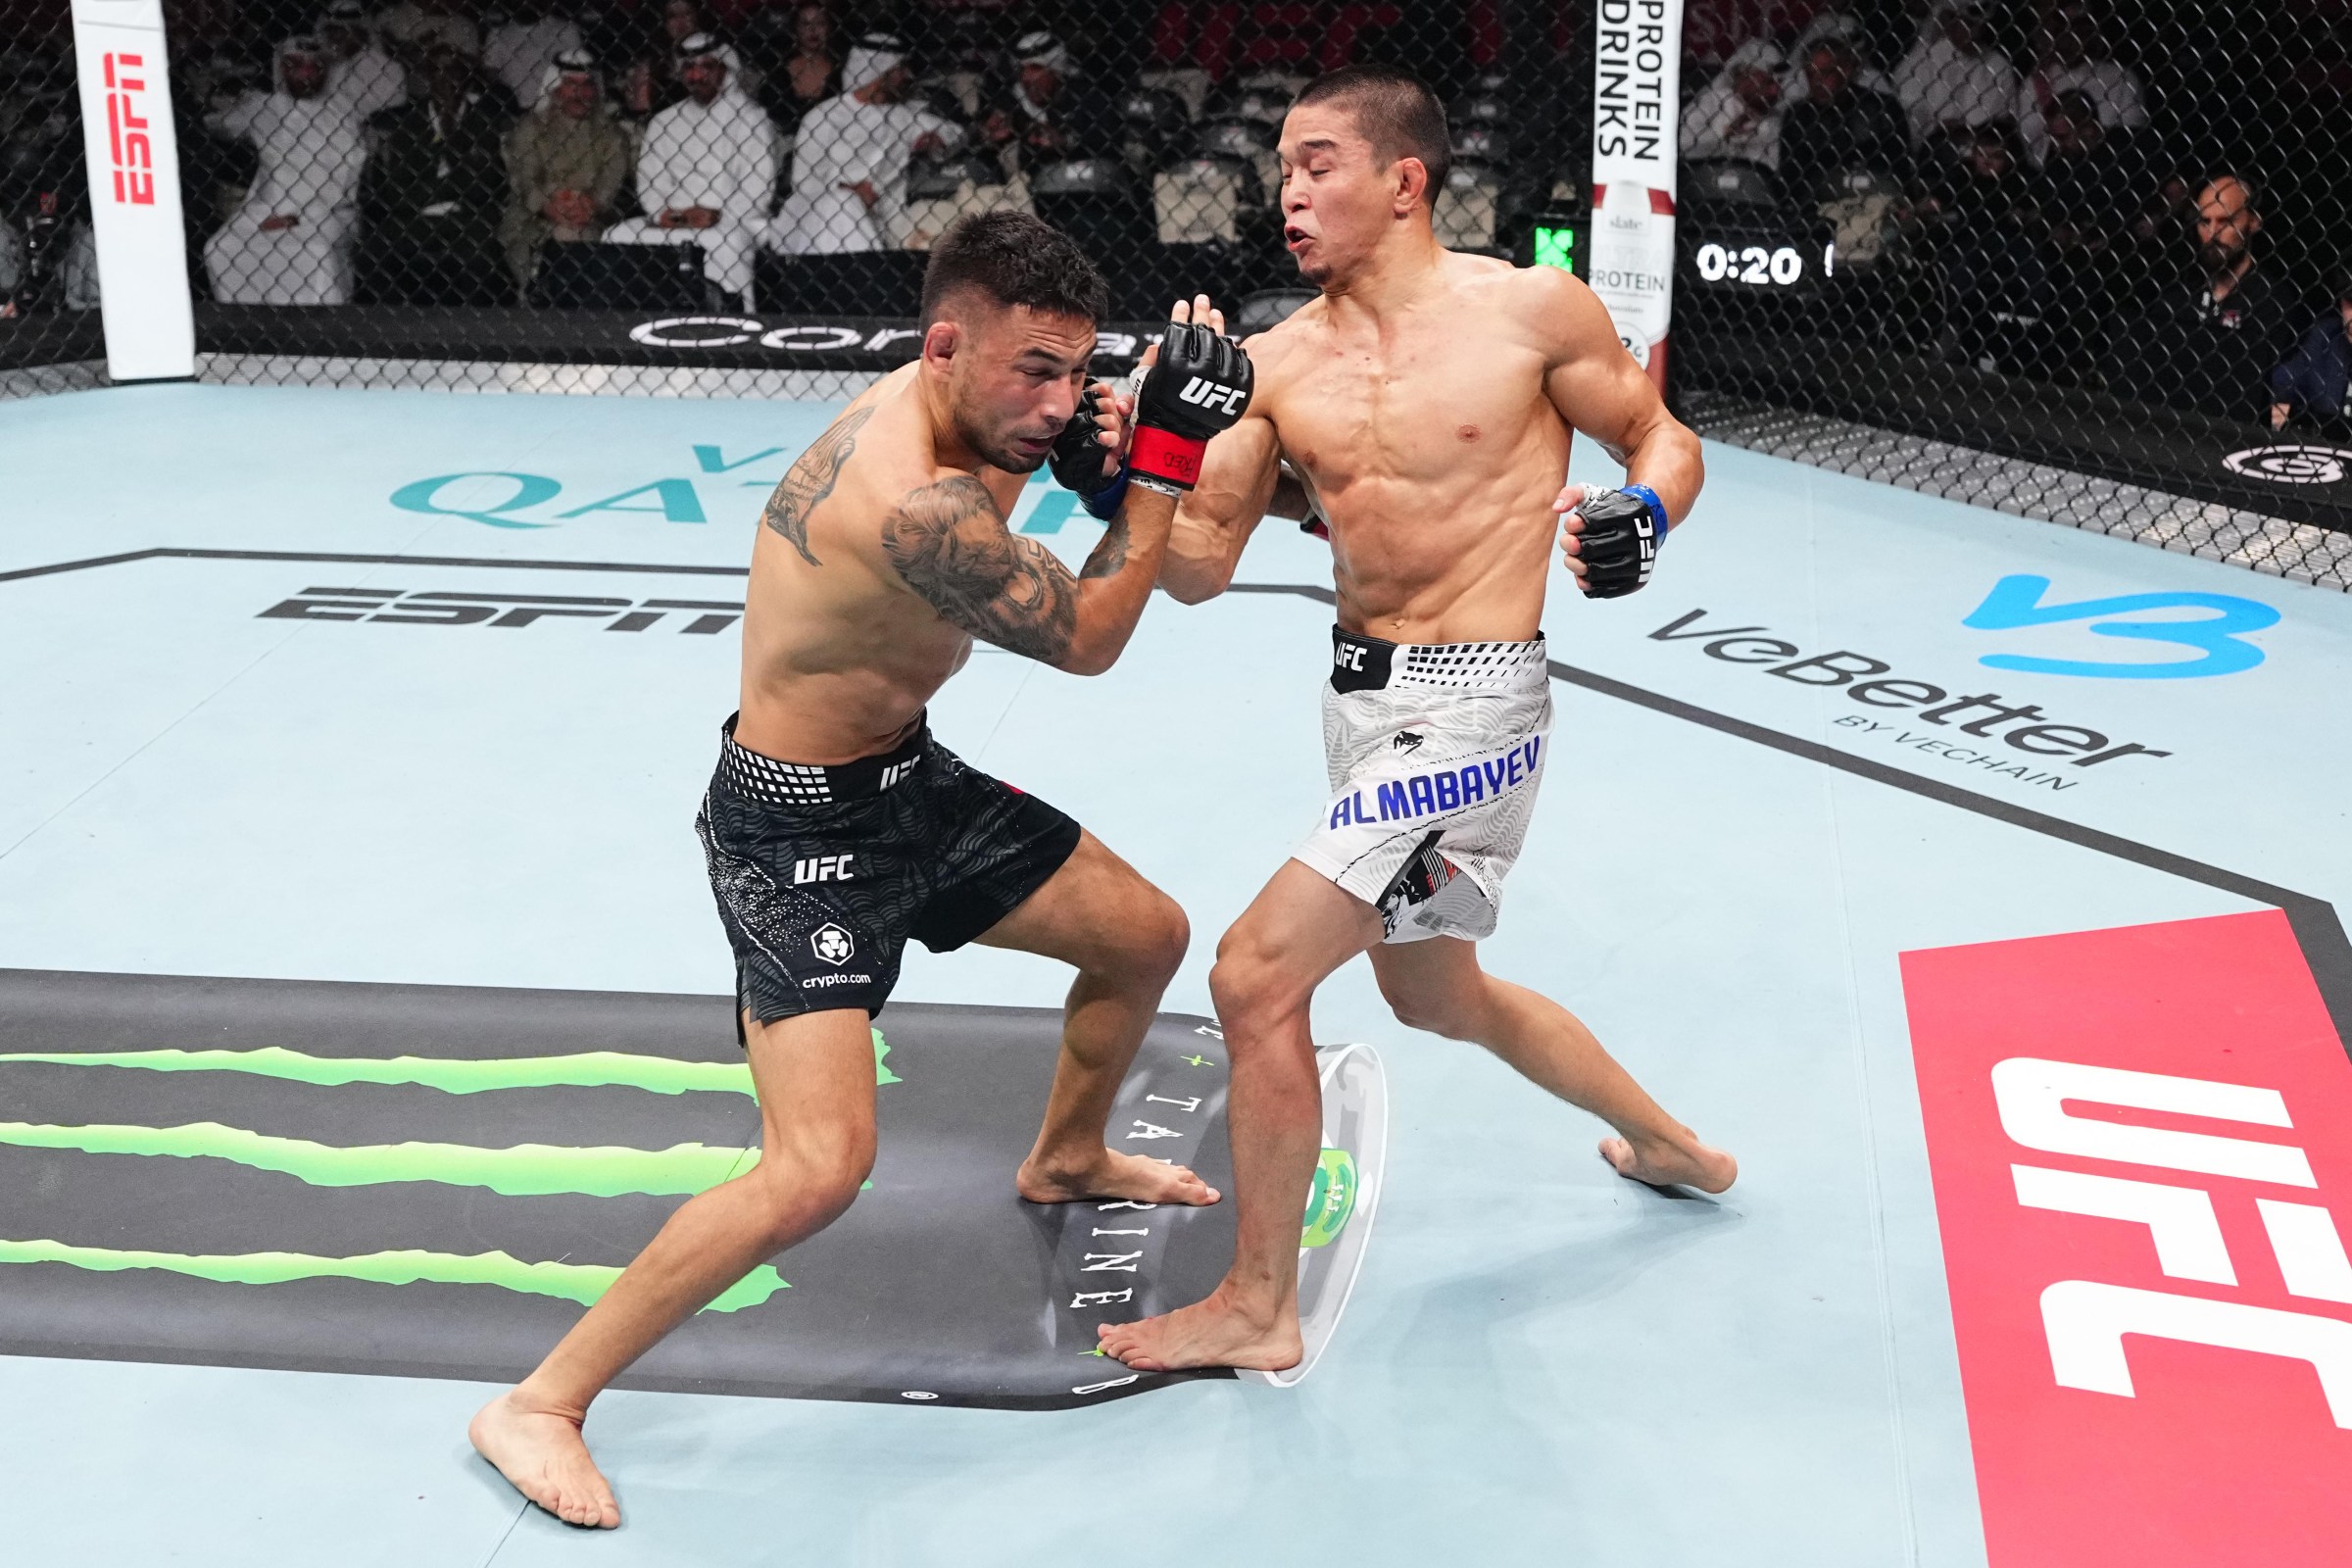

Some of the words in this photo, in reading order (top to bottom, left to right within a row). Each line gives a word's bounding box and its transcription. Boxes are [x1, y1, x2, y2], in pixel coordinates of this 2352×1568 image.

[1598, 0, 1630, 157] DRINKS
[1633, 0, 1664, 161] PROTEIN
[103, 52, 155, 205] ESPN
[1696, 244, 1802, 285] 0:20
[1179, 376, 1247, 416] UFC
[1634, 515, 1655, 583] UFC
[254, 586, 745, 634] ESPN
[1336, 642, 1368, 672] UFC
[1646, 608, 2173, 768] VeBetter
[1330, 735, 1540, 831] ALMABAYEV
[1833, 714, 1894, 732] BY
[1894, 731, 2079, 791] VECHAIN
[794, 854, 854, 885] UFC
[802, 971, 871, 989] crypto.com
[1069, 1094, 1201, 1308] TARINE
[1990, 1056, 2352, 1431] UFC
